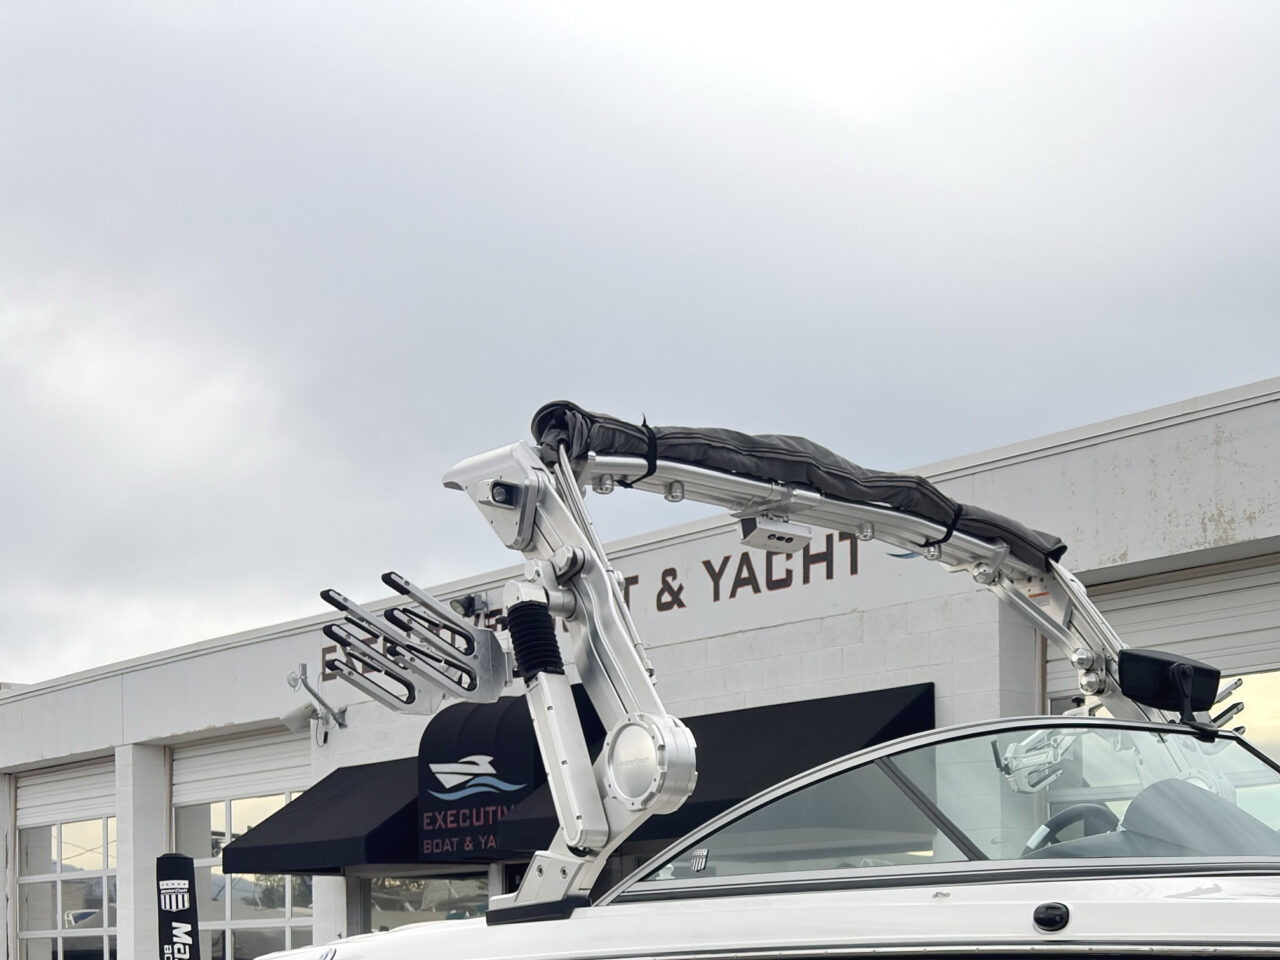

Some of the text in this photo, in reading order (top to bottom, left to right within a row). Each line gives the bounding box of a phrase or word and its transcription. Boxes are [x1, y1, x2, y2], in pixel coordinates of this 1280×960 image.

[656, 567, 687, 612] &
[701, 531, 858, 602] YACHT
[423, 803, 516, 830] EXECUTIV
[423, 837, 459, 854] BOAT
[464, 836, 474, 851] &
